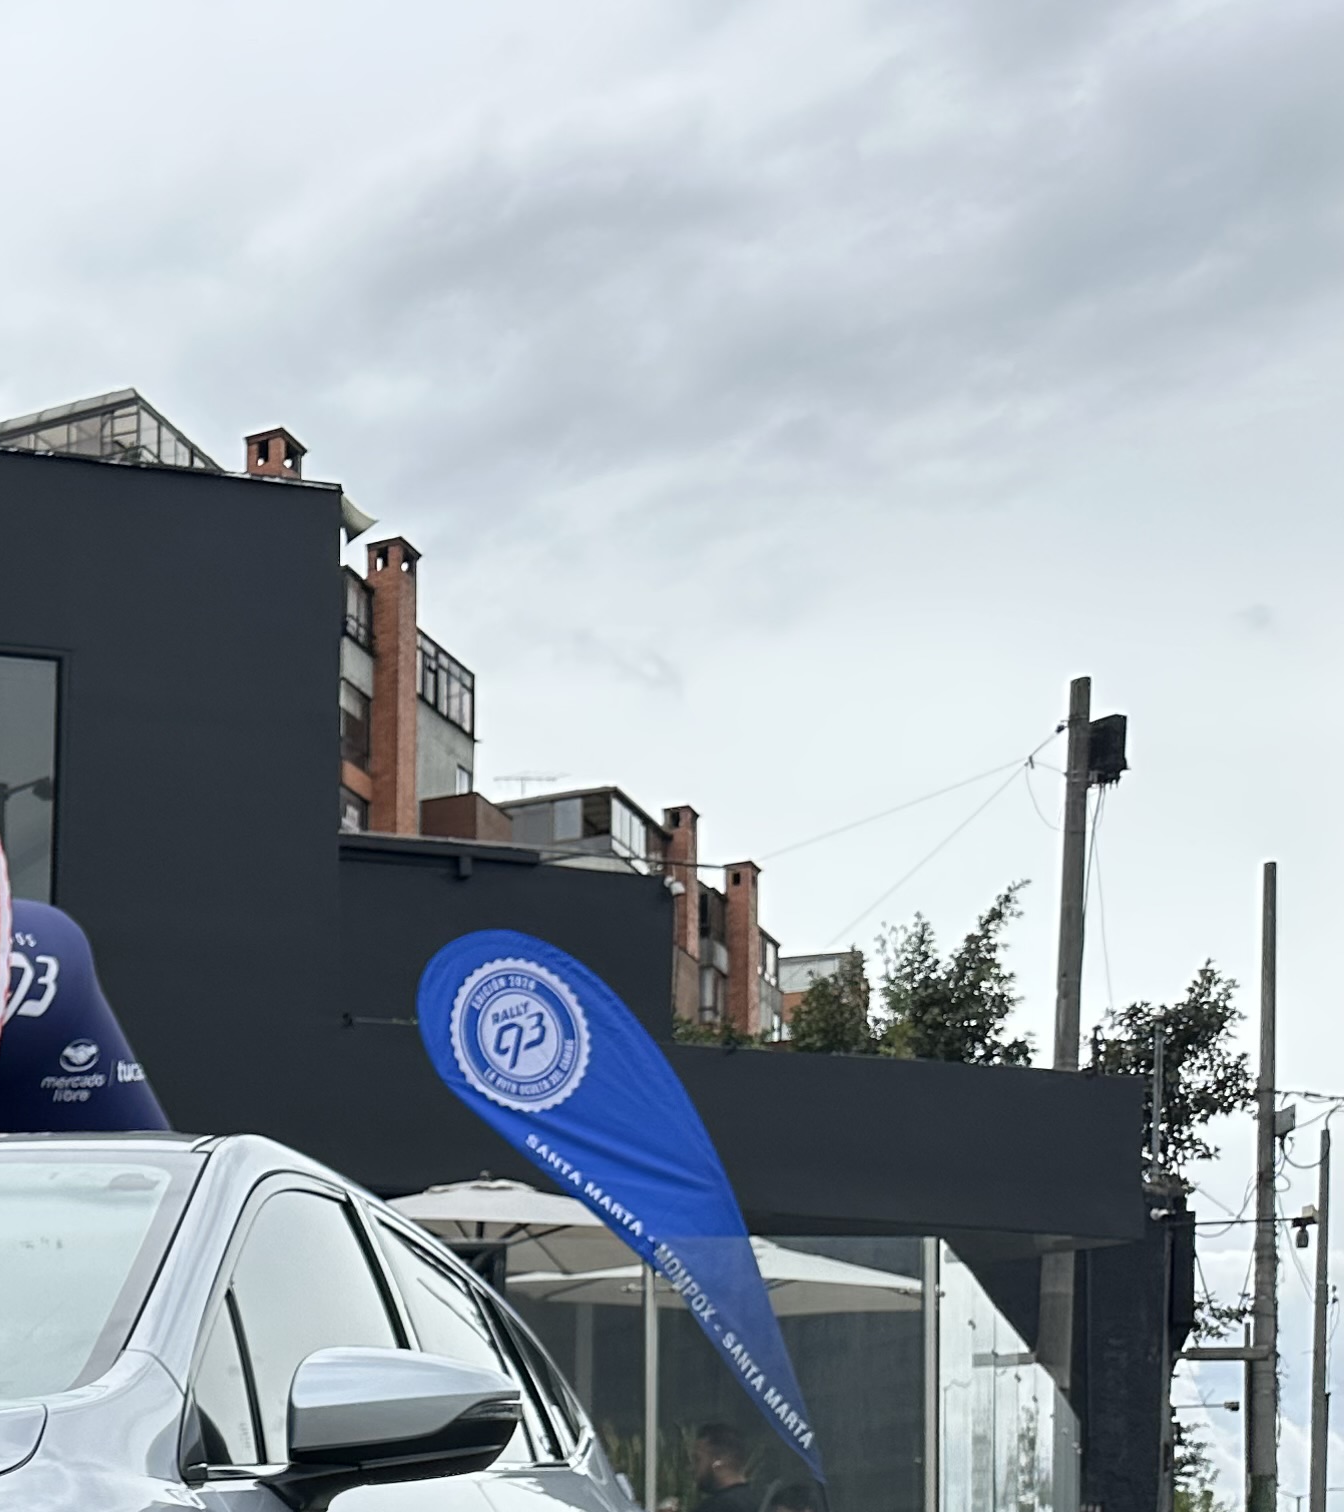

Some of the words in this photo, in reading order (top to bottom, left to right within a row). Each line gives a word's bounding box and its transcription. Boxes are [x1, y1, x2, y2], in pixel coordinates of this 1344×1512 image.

[491, 1000, 530, 1025] RALLY
[493, 1011, 546, 1070] 93
[40, 1072, 107, 1090] mercado
[116, 1060, 147, 1083] tuca
[52, 1088, 92, 1103] libre
[525, 1133, 583, 1186] SANTA
[583, 1181, 644, 1237] MARTA
[653, 1242, 716, 1324] MOMPOX
[721, 1331, 768, 1393] SANTA
[762, 1386, 816, 1450] MARTA
